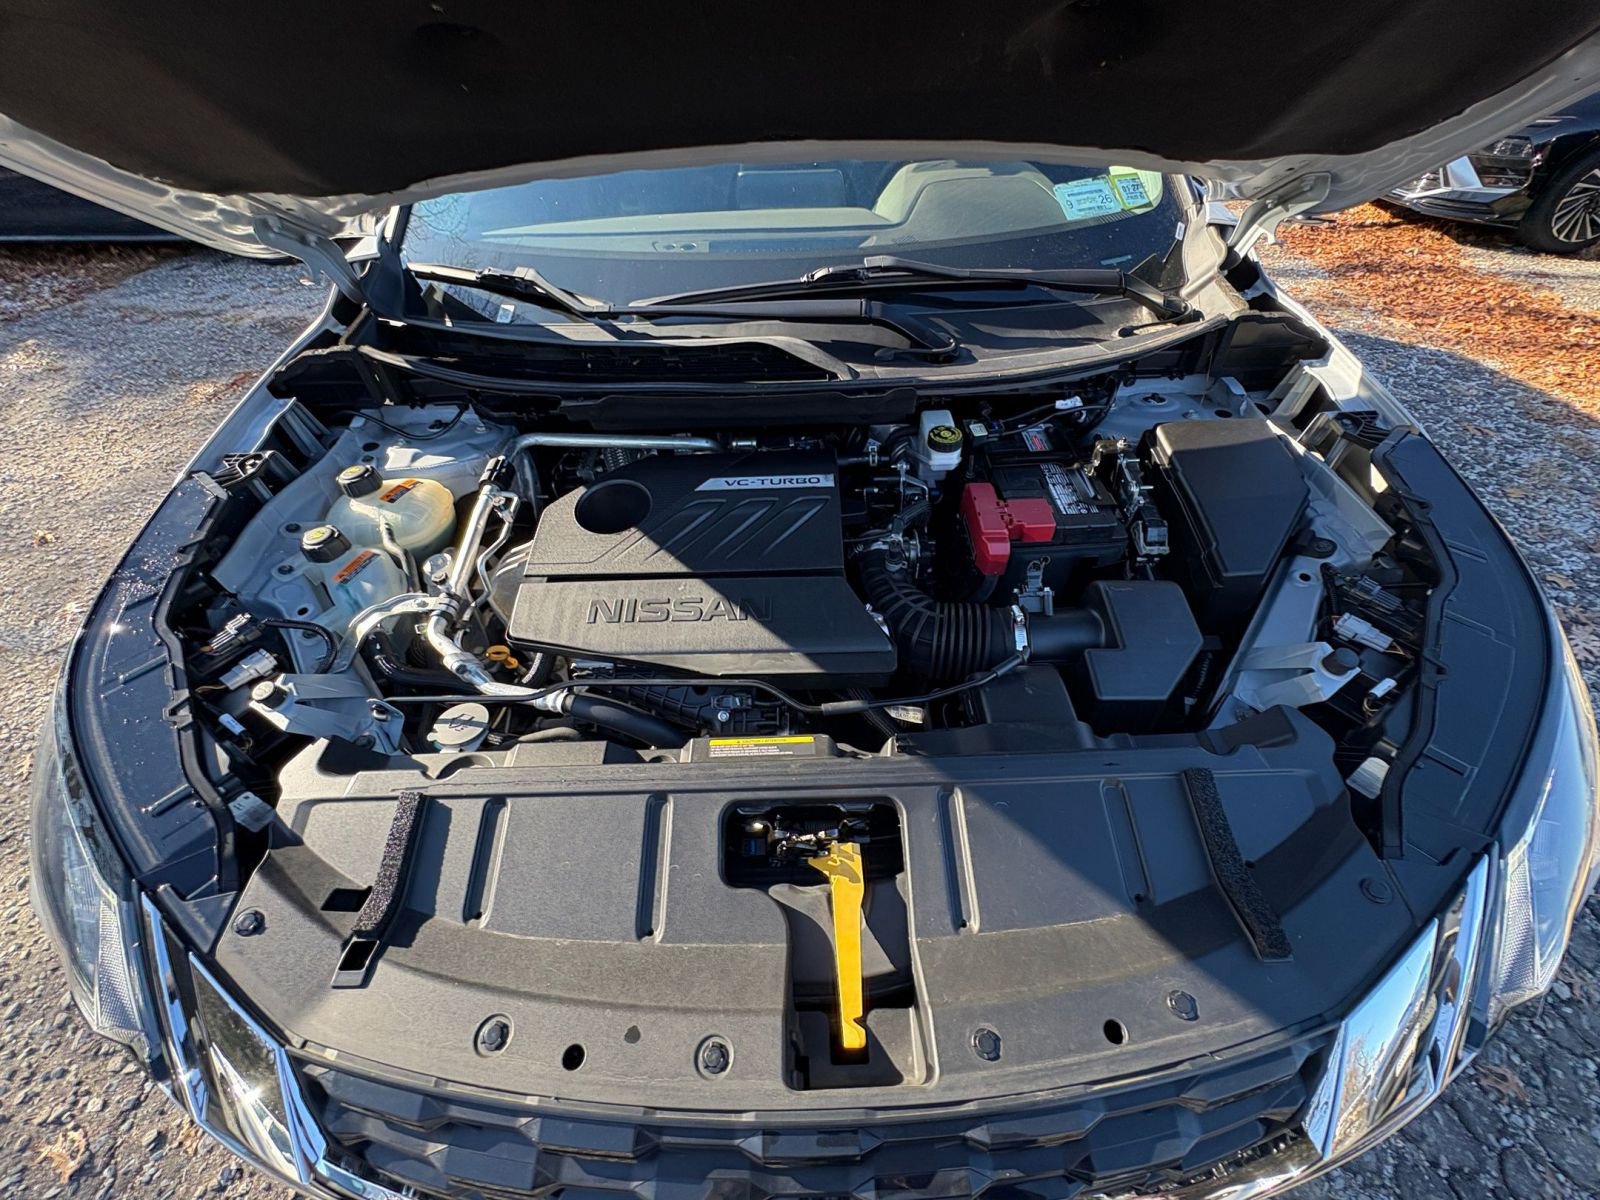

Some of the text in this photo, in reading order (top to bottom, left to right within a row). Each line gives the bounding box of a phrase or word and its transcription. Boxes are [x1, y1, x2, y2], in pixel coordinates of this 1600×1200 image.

[1098, 193, 1113, 204] 26
[724, 477, 821, 487] VC-TURBO
[586, 597, 772, 624] NISSAN
